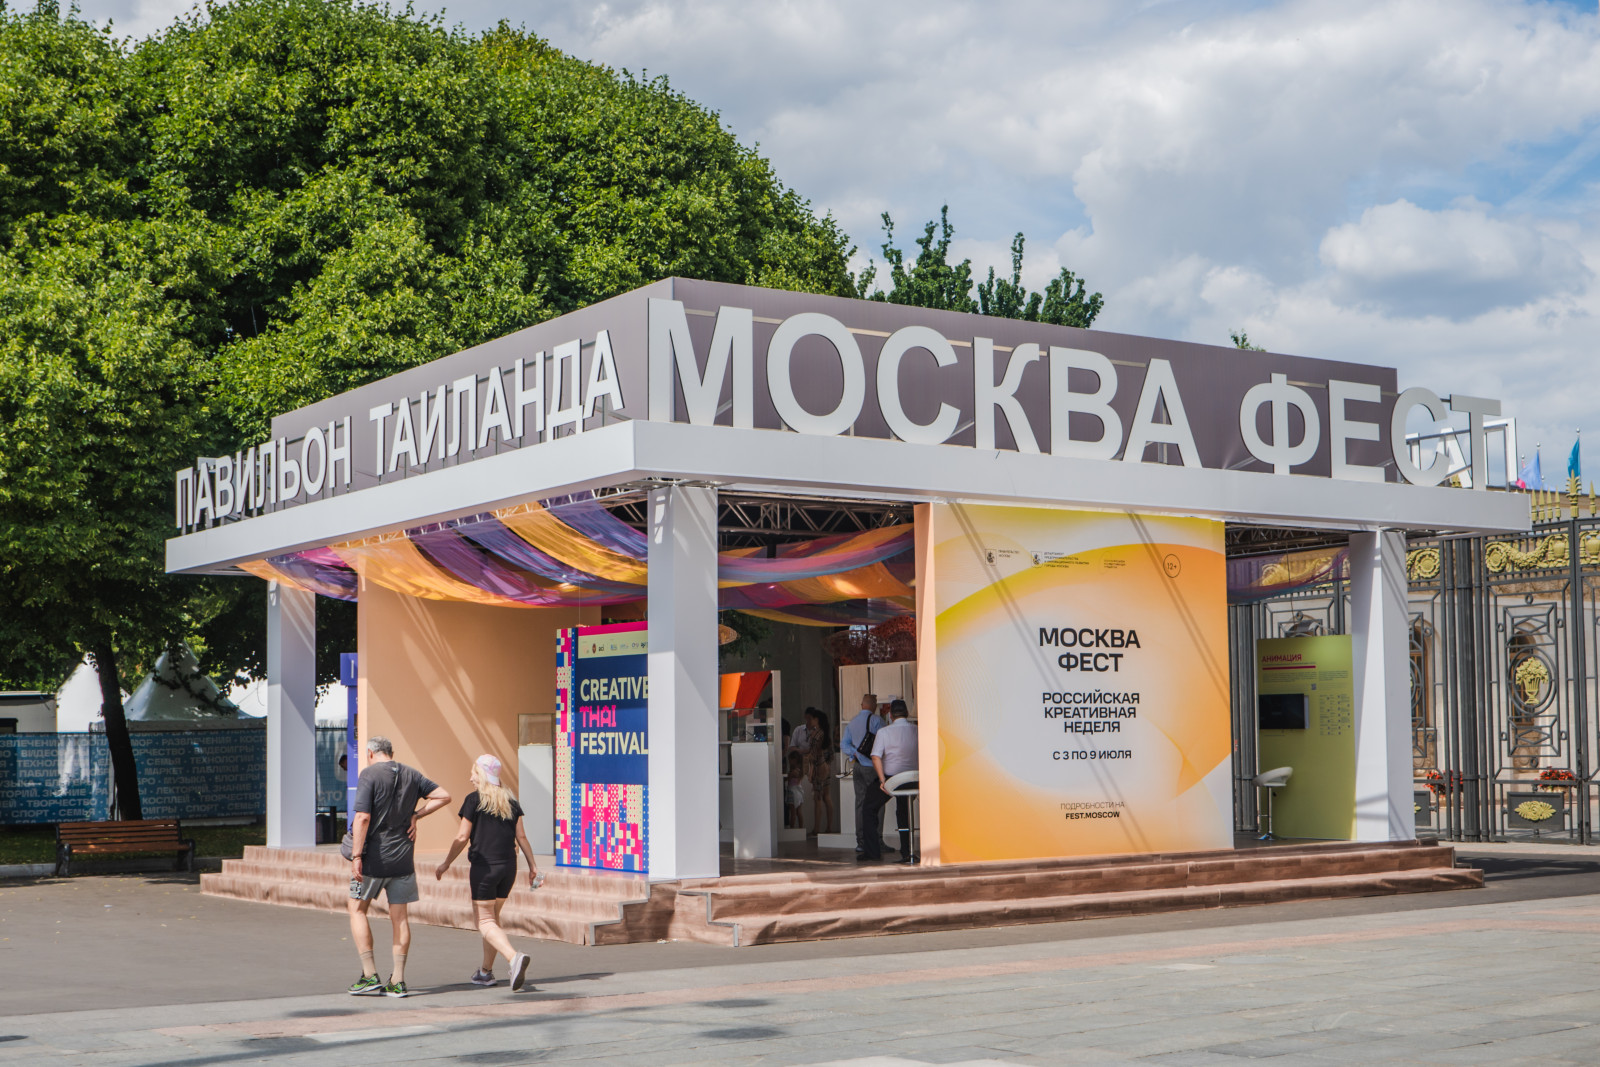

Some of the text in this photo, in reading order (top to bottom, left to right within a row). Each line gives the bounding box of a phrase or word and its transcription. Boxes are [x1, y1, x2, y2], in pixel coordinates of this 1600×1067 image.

[648, 298, 1203, 469] МОСКВА
[1239, 372, 1501, 491] ФЕСТ
[175, 329, 624, 529] ПАВИЛЬОН ТАИЛАНДА
[1167, 562, 1177, 570] 12+
[1039, 627, 1141, 648] МОСКВА
[1058, 652, 1124, 672] ФЕСТ
[1262, 654, 1302, 662] АНИМАЦИЯ
[580, 676, 648, 702] CREATIVE
[1042, 689, 1140, 704] РОССИЙСКАЯ
[579, 704, 617, 728] THAI
[1044, 706, 1137, 719] КРЕАТИВНАЯ
[1064, 721, 1121, 735] НЕДЕЛЯ
[131, 735, 266, 747] МОР РАЗВЛЕЧЕНИЯ КОСП
[580, 731, 649, 755] FESTIVAL
[132, 747, 186, 756] ОРЧЕСТВО
[194, 745, 255, 755] ВИДЕОИГРЫ
[1052, 750, 1132, 760] С 3 ПО 9 ИЮЛЯ
[146, 757, 181, 766] СЕМЬЯ
[190, 754, 254, 764] ТЕХНОЛОГИИ
[19, 769, 64, 777] ПАБЛИ
[144, 767, 183, 776] МАРКЕТ
[163, 776, 206, 785] МУЗЫКА
[215, 773, 260, 782] БЛОГЕРЫ
[42, 788, 87, 797] ЗНИЕ
[142, 792, 262, 805] КОСПЛЕЙ ТВОРЧЕСТВО
[26, 798, 98, 807] ТВОРЧЕСТВО
[141, 801, 260, 815] ОИГРЫ СПОРТ СЕМЬЯ
[1060, 801, 1114, 810] ПОДРОБНОСТИ
[11, 809, 49, 818] СПОРТ
[59, 808, 96, 816] СЕМЬЯ
[1065, 811, 1120, 820] FEST.MOSCOW
